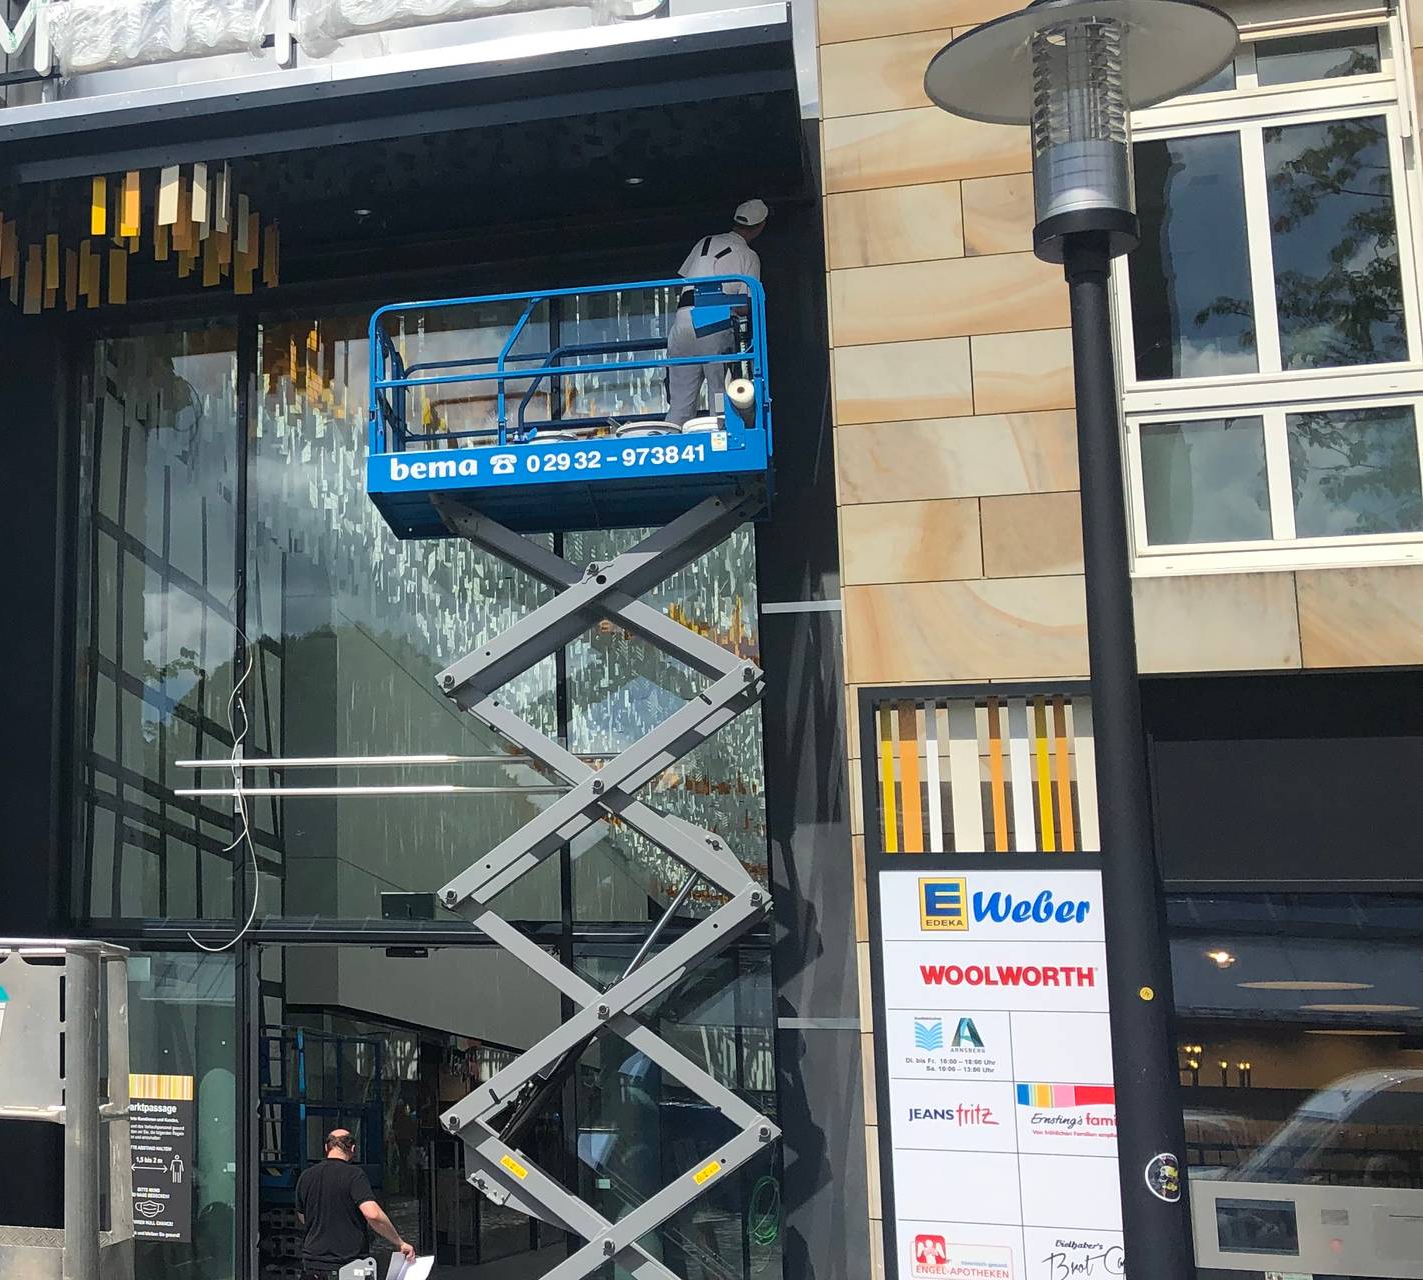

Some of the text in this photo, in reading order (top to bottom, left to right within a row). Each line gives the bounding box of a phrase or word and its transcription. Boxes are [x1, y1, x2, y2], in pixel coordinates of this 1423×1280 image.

[622, 444, 705, 466] 973841
[390, 457, 477, 481] bema
[973, 890, 1090, 923] Weber
[925, 919, 963, 927] EDEKA
[919, 965, 1095, 987] WOOLWORTH
[128, 1102, 177, 1115] arktpassage
[908, 1103, 1000, 1127] JEANS fritz
[1031, 1112, 1118, 1129] Ernsting's fami
[915, 1265, 1009, 1279] ENGEL-APOTHEKEN
